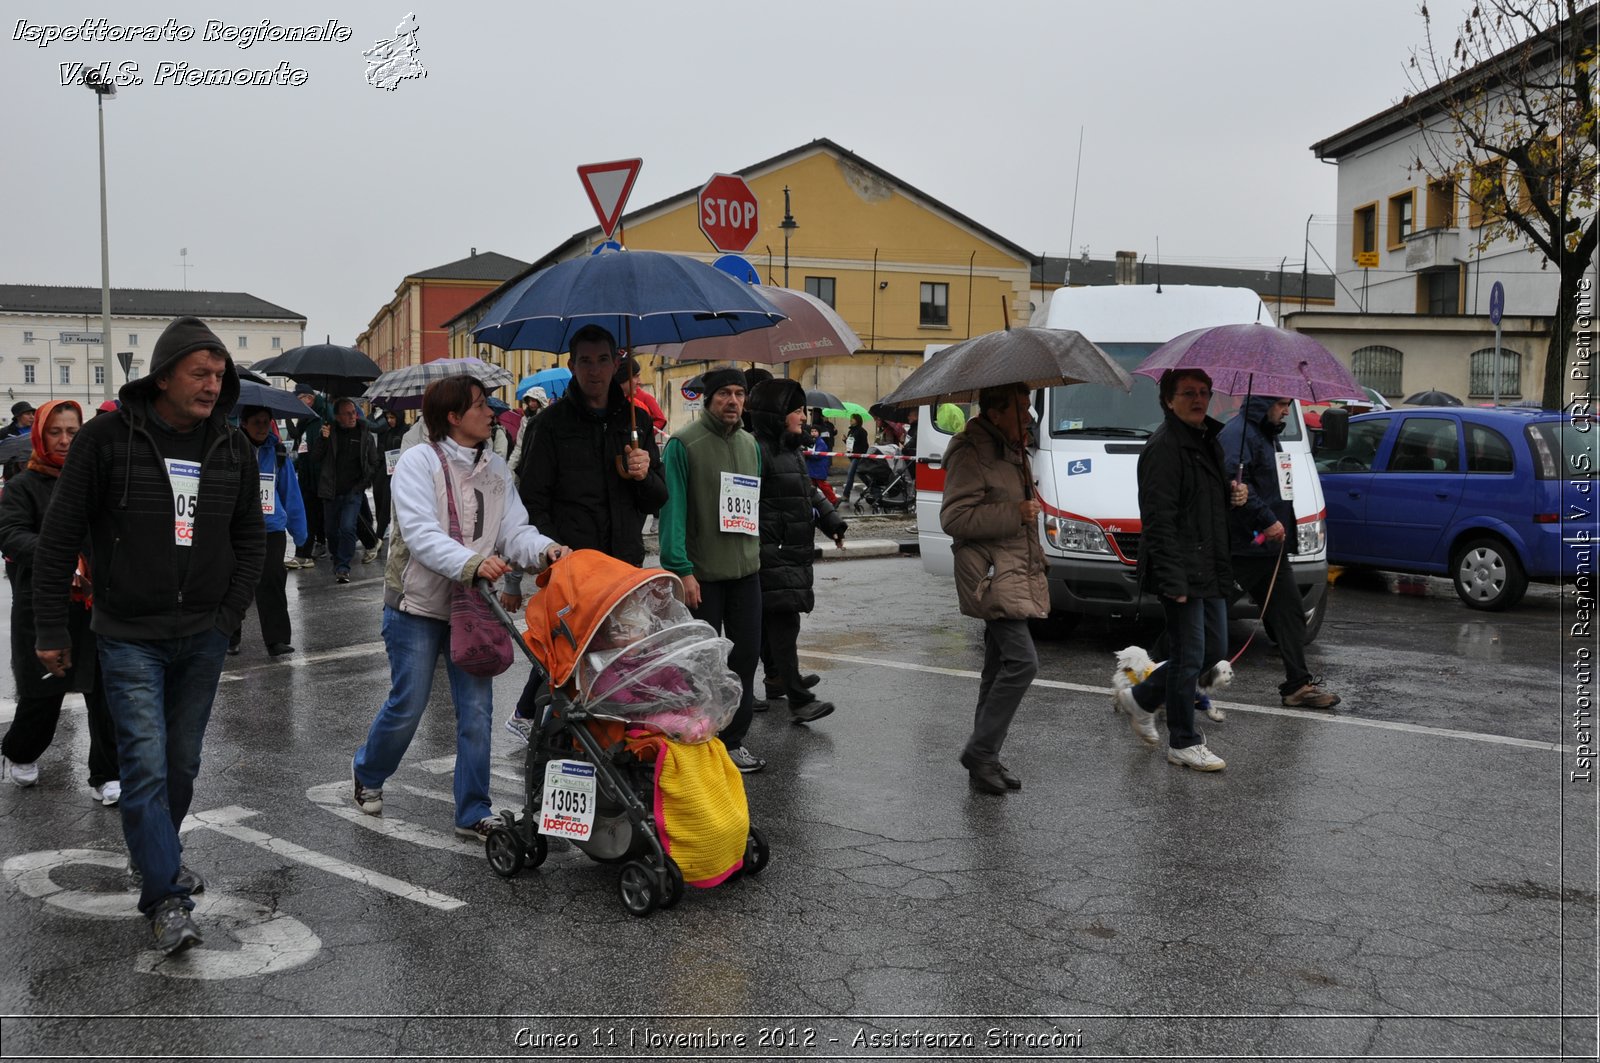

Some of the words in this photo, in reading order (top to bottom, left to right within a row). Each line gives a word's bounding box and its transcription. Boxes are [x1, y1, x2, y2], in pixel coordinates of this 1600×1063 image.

[704, 197, 756, 230] STOP
[728, 496, 751, 515] 8829
[551, 789, 586, 814] 13053
[544, 814, 589, 836] ipercoop
